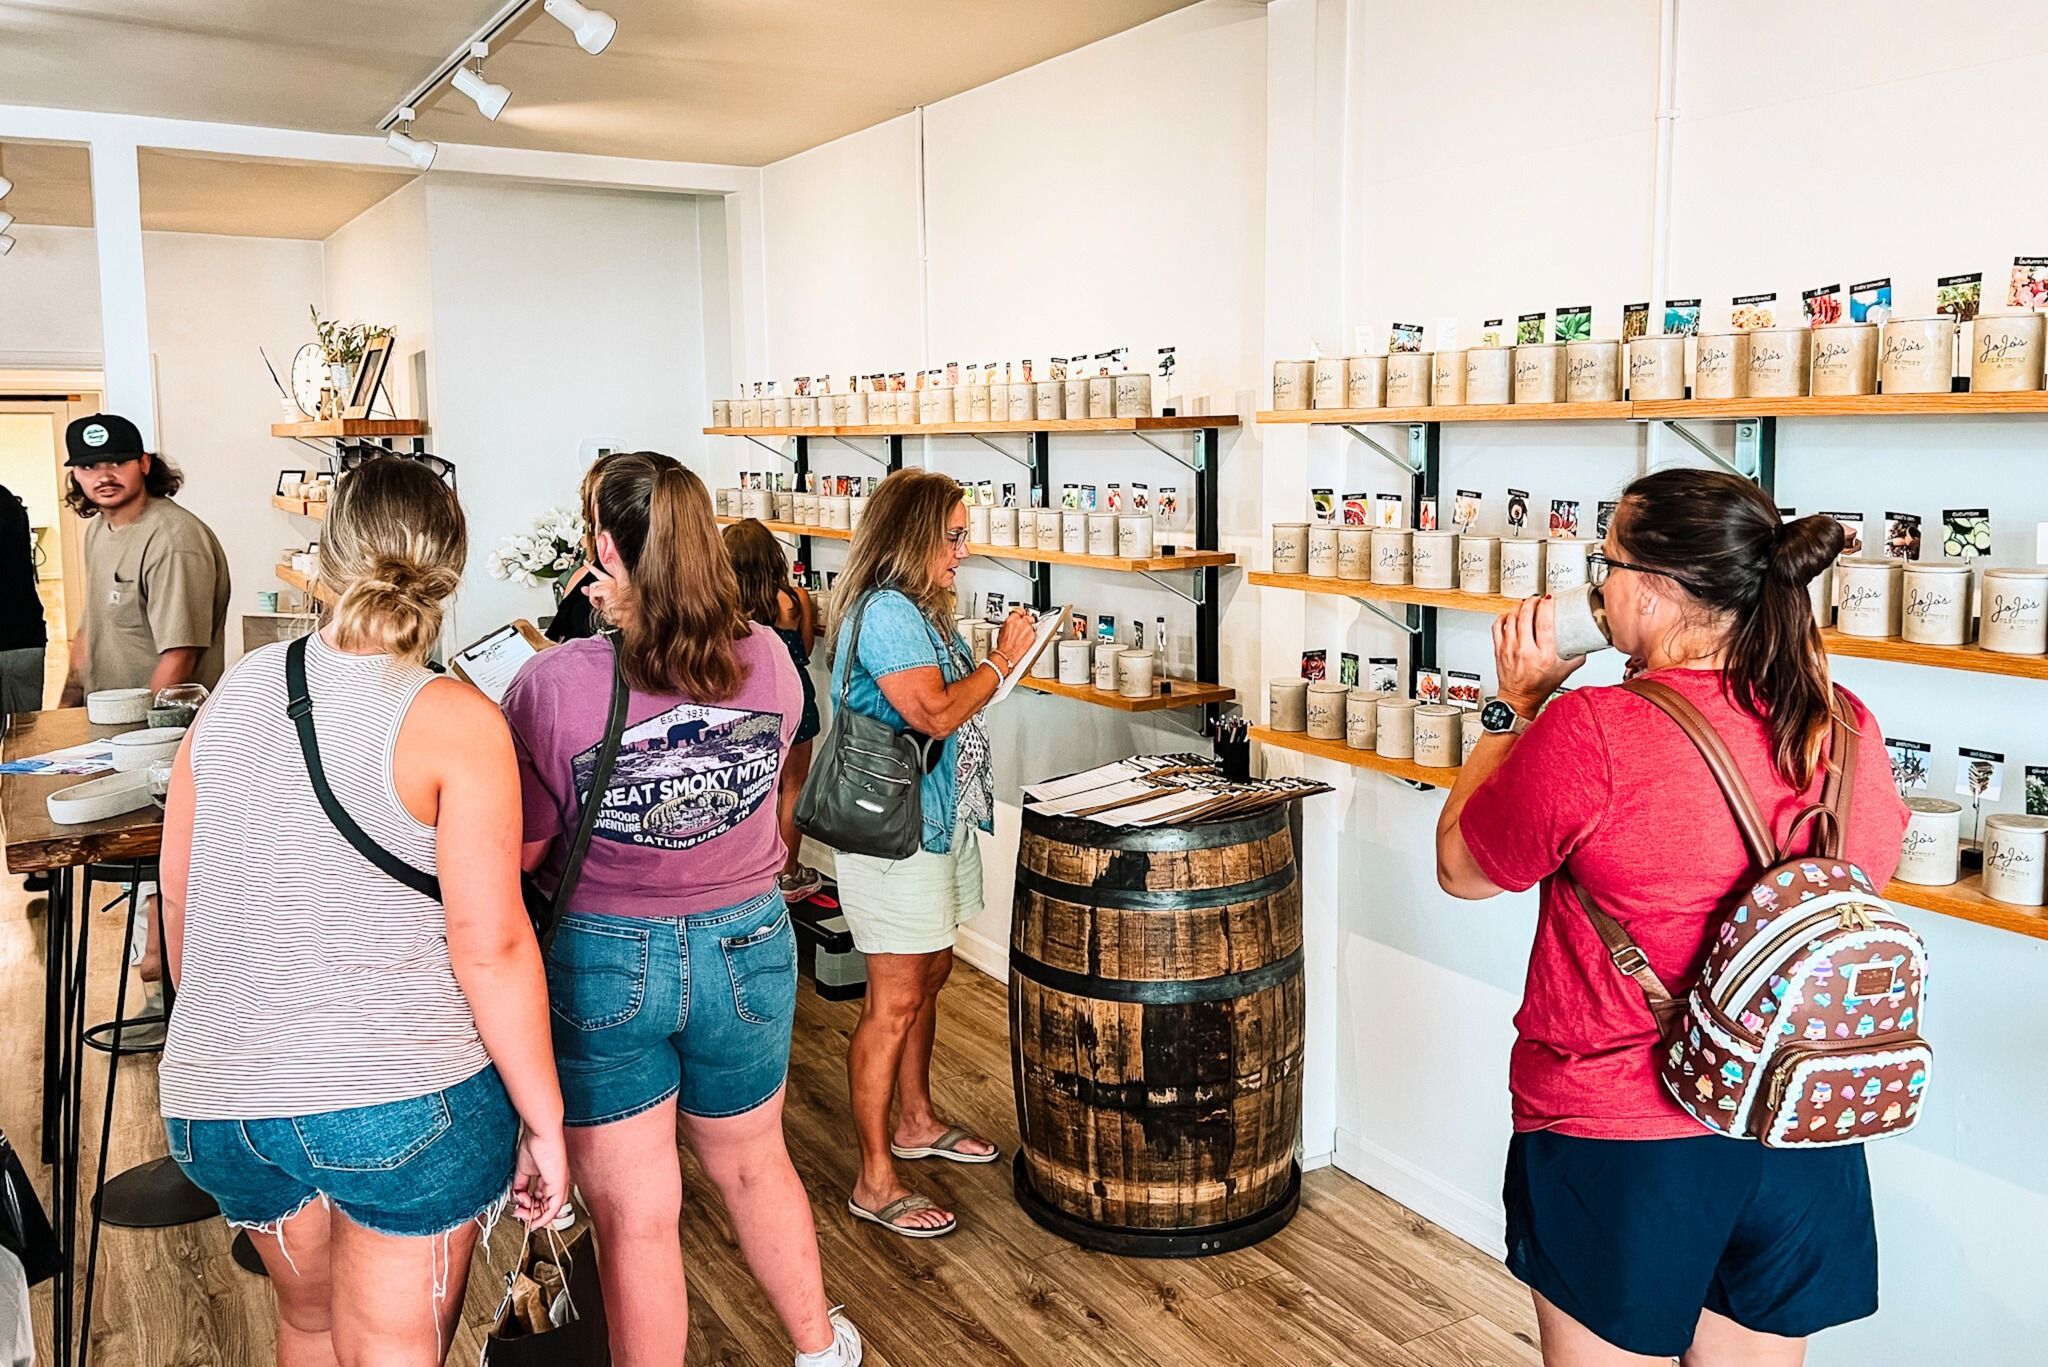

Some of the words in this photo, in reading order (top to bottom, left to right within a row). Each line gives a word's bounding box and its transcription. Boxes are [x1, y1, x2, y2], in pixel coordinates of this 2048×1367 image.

[660, 713, 683, 726] EST.
[686, 708, 710, 721] 1934
[659, 768, 735, 800] SMOKY
[736, 752, 778, 785] MTNS
[739, 780, 772, 809] PARADISE
[597, 808, 641, 823] UTDOOR
[592, 818, 642, 834] DVENTURE
[633, 822, 731, 849] GATLINBURG,
[734, 806, 750, 822] TN
[1902, 830, 1937, 850] oJo's
